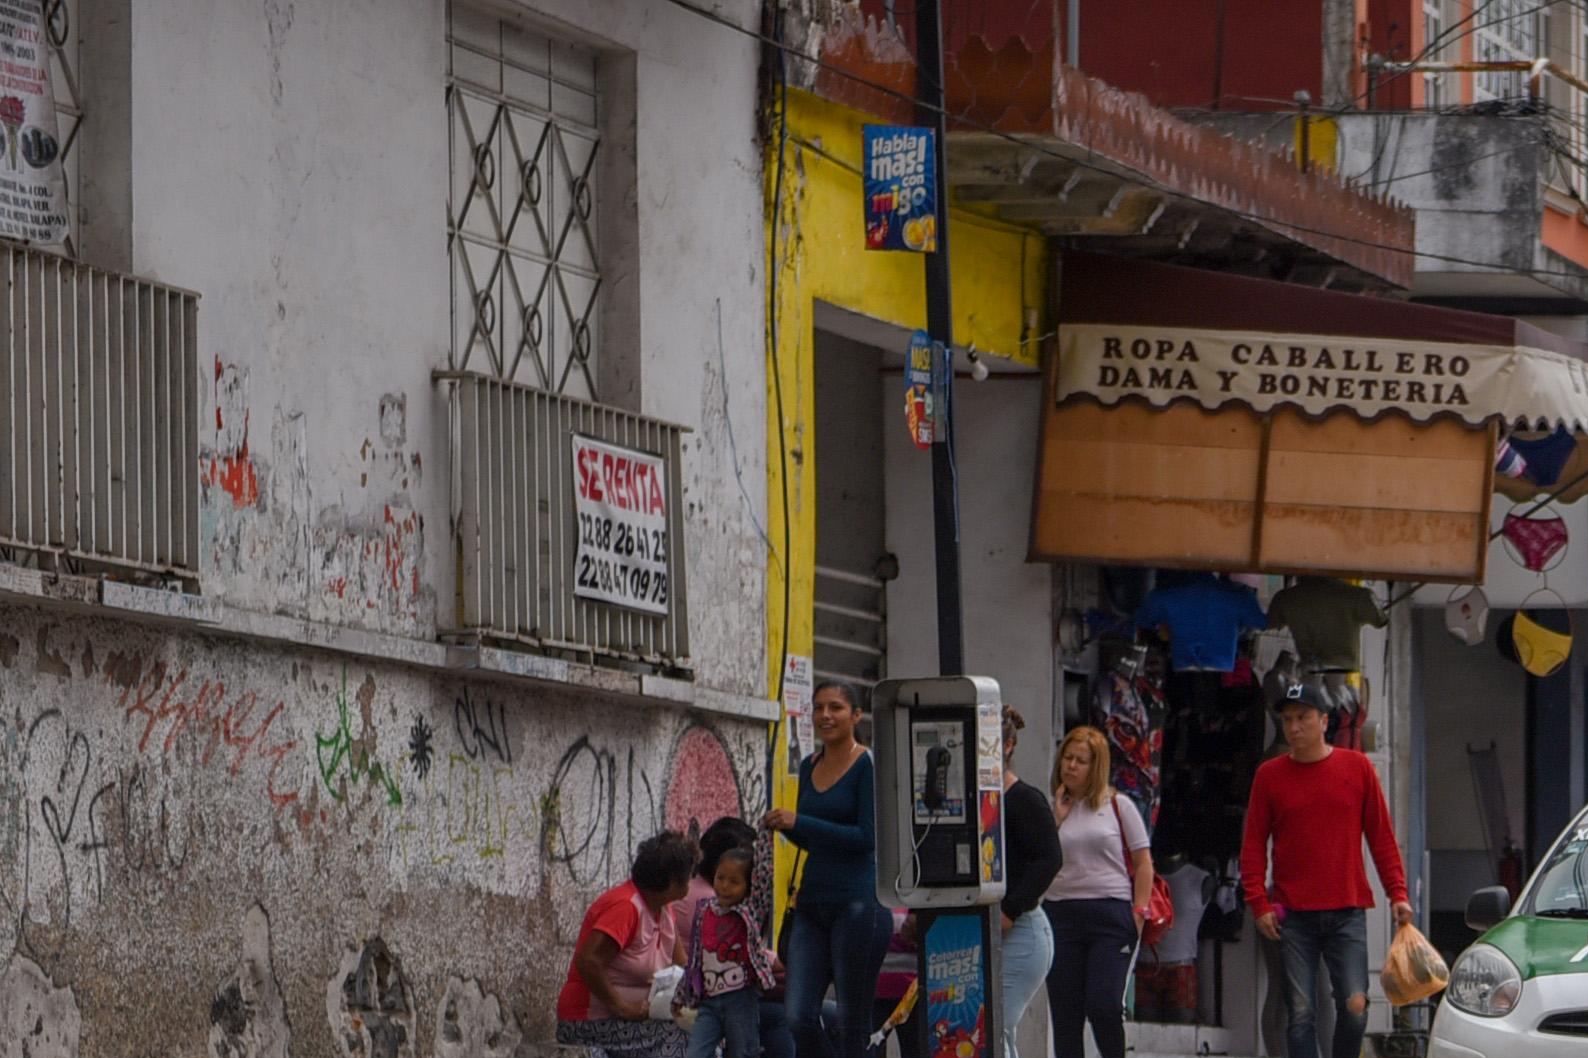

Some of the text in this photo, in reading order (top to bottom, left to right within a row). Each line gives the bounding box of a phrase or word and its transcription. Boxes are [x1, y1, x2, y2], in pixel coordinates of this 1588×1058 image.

[872, 133, 917, 157] Habla
[902, 173, 925, 187] con
[1102, 337, 1471, 378] ROPA CABALLERO
[1097, 365, 1471, 406] DAMA Y BONETERIA
[577, 447, 666, 517] SE RENTA
[614, 521, 635, 557] 26
[578, 554, 614, 594] 2288
[613, 563, 628, 598] 47
[630, 567, 650, 601] 09
